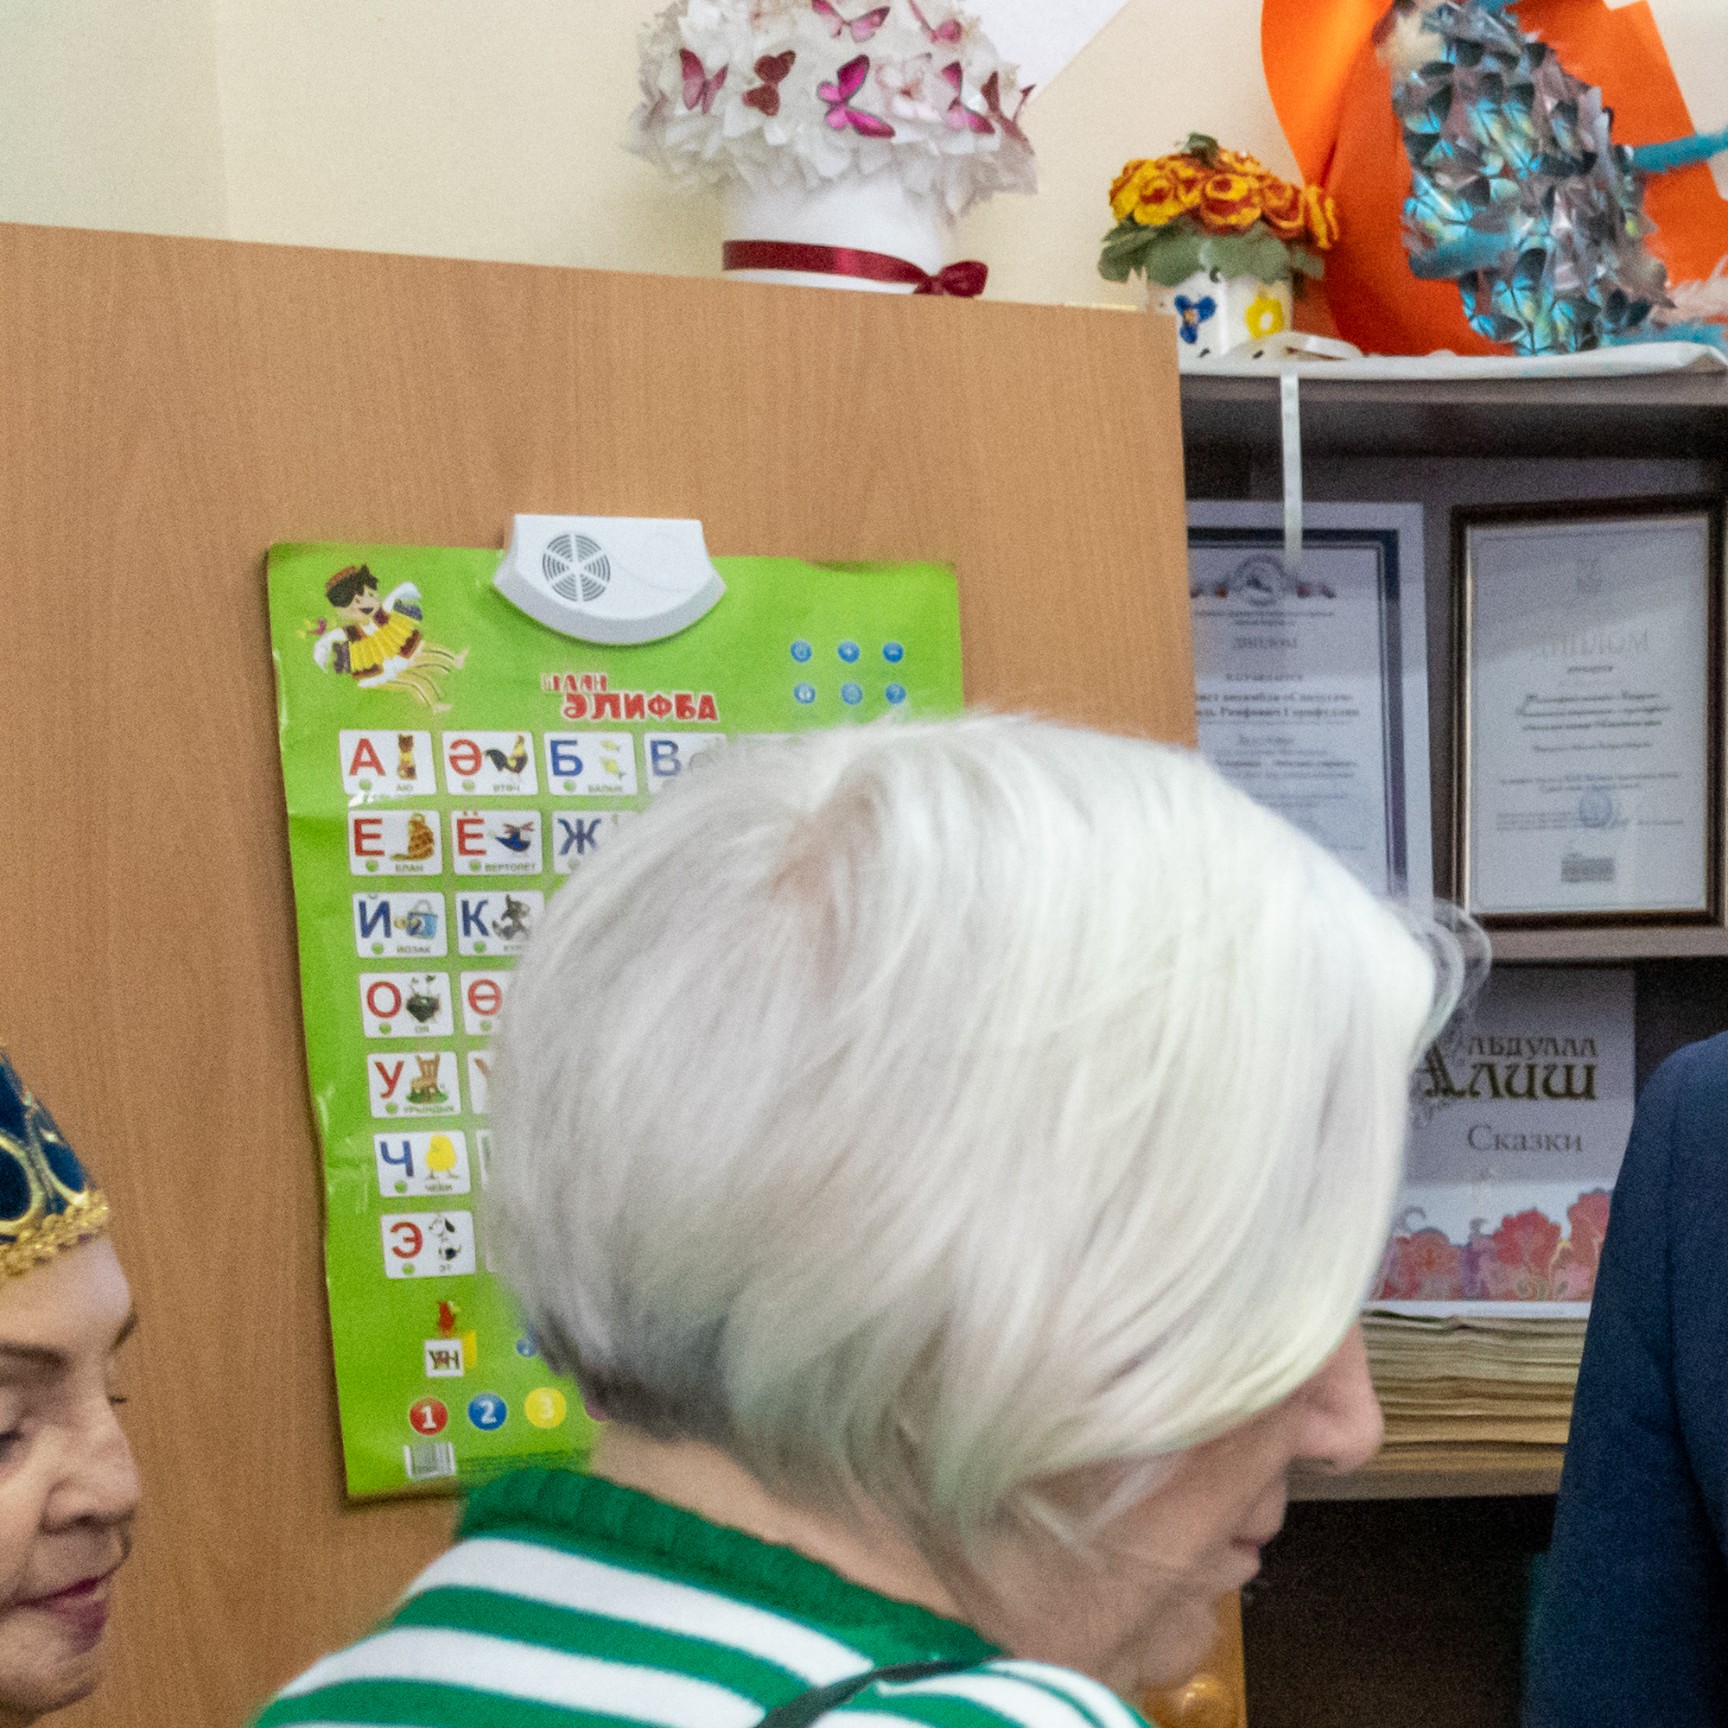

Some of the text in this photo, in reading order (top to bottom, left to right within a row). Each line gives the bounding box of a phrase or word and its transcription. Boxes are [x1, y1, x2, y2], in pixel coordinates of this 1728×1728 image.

[564, 692, 720, 722] ӘЛИФБА
[349, 738, 386, 776] А
[449, 738, 483, 776] Ә
[550, 739, 584, 777] Б
[649, 739, 682, 777] В
[353, 818, 385, 857] Е
[456, 810, 487, 857] Ё
[557, 817, 602, 856] Ж
[358, 893, 392, 939] Й
[461, 899, 490, 938] К
[366, 980, 402, 1019] О
[468, 979, 503, 1017] Ө
[373, 1060, 405, 1099] У
[379, 1140, 415, 1177] Ч
[1466, 1124, 1583, 1155] Сказки
[389, 1221, 424, 1259] Э
[421, 1396, 554, 1430] 1 2 3
